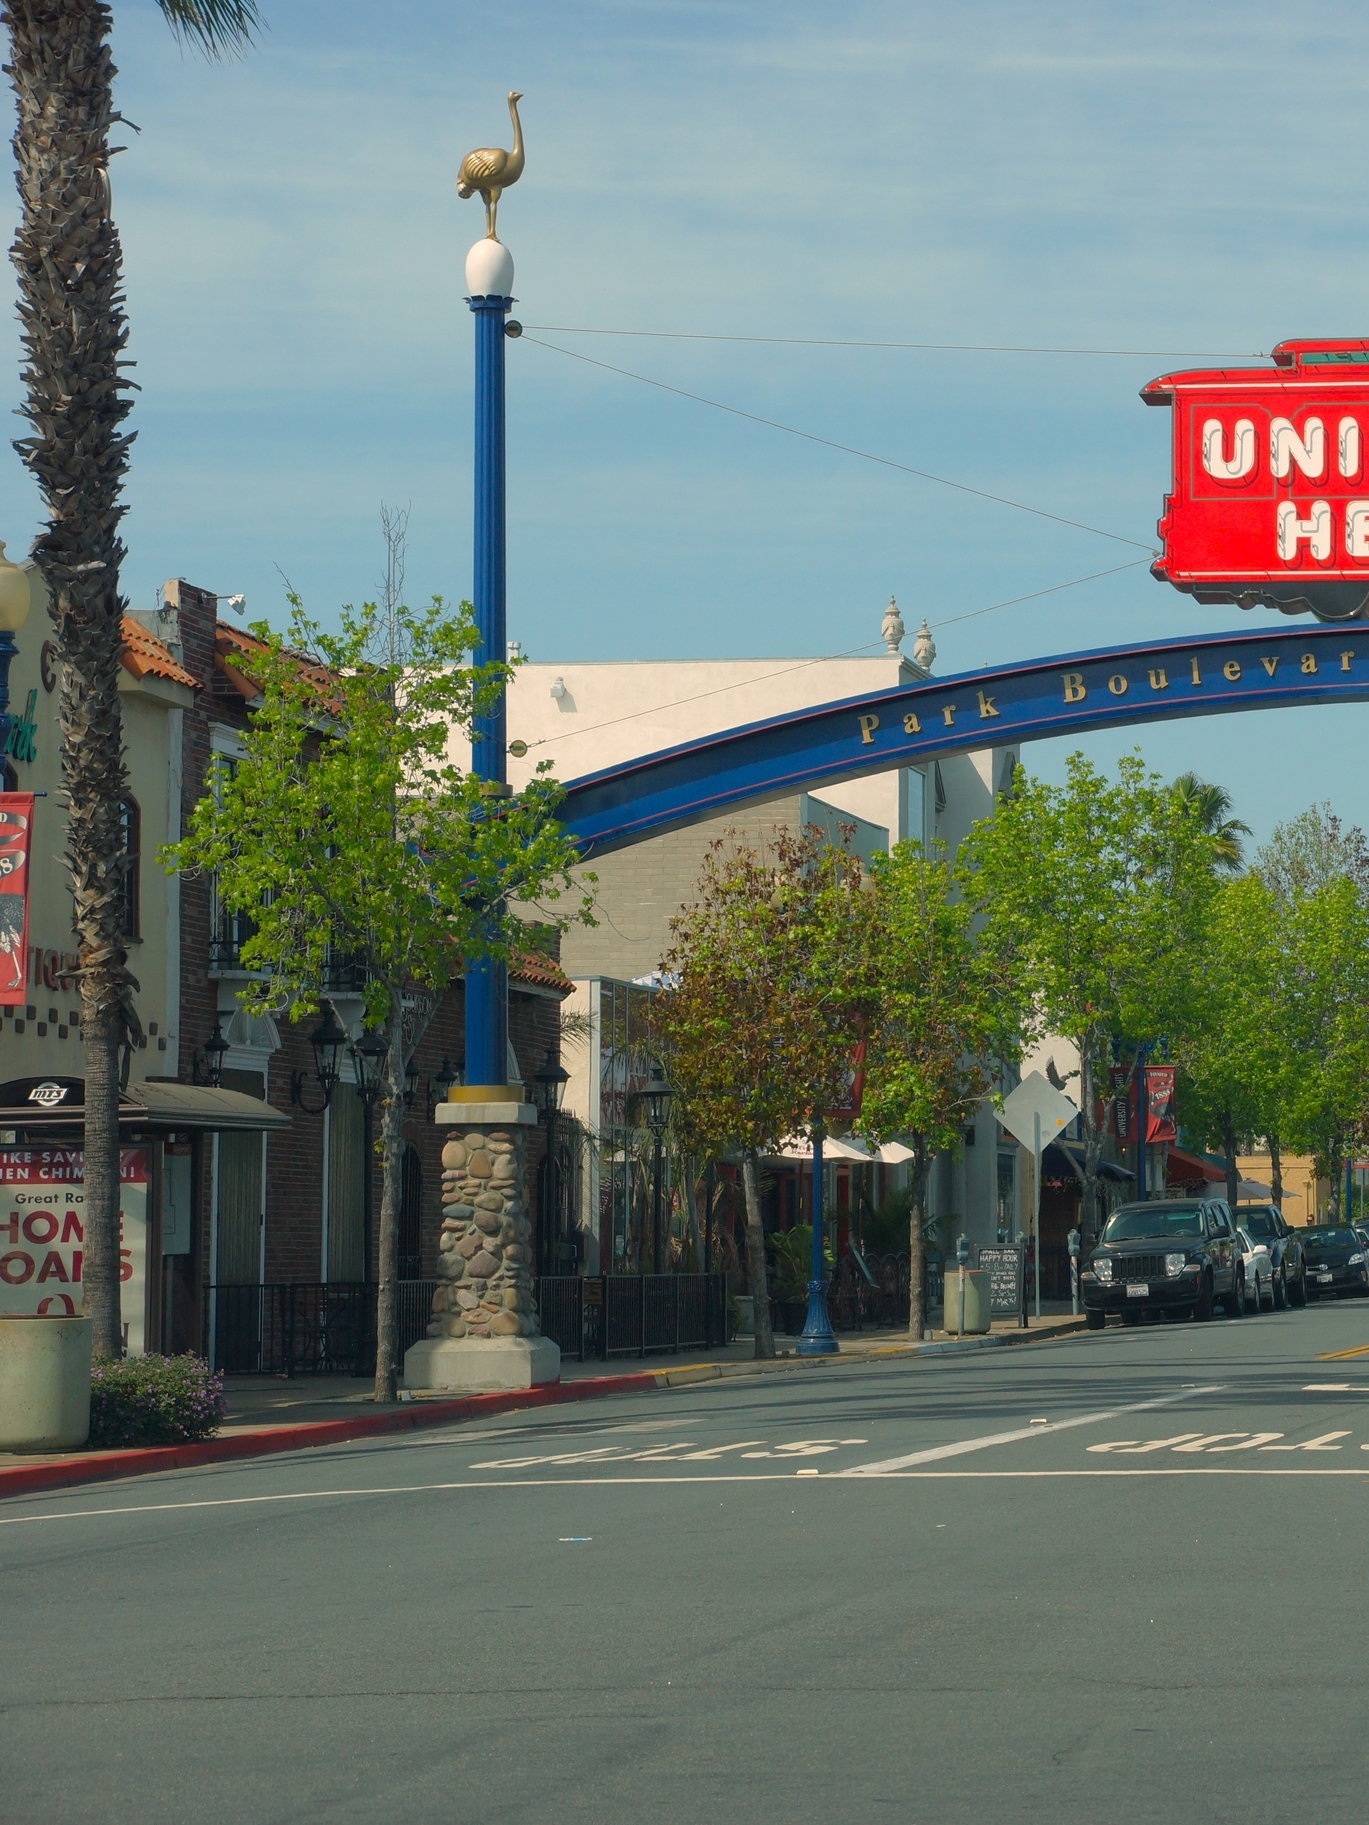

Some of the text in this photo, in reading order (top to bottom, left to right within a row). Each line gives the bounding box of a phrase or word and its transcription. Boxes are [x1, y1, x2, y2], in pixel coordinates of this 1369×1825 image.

[857, 690, 1000, 744] Park
[32, 1089, 63, 1098] MTS
[1117, 1101, 1127, 1137] UNIVERSITY
[3, 1152, 32, 1163] IKE
[39, 1167, 85, 1179] CHIM
[15, 1193, 59, 1204] Great
